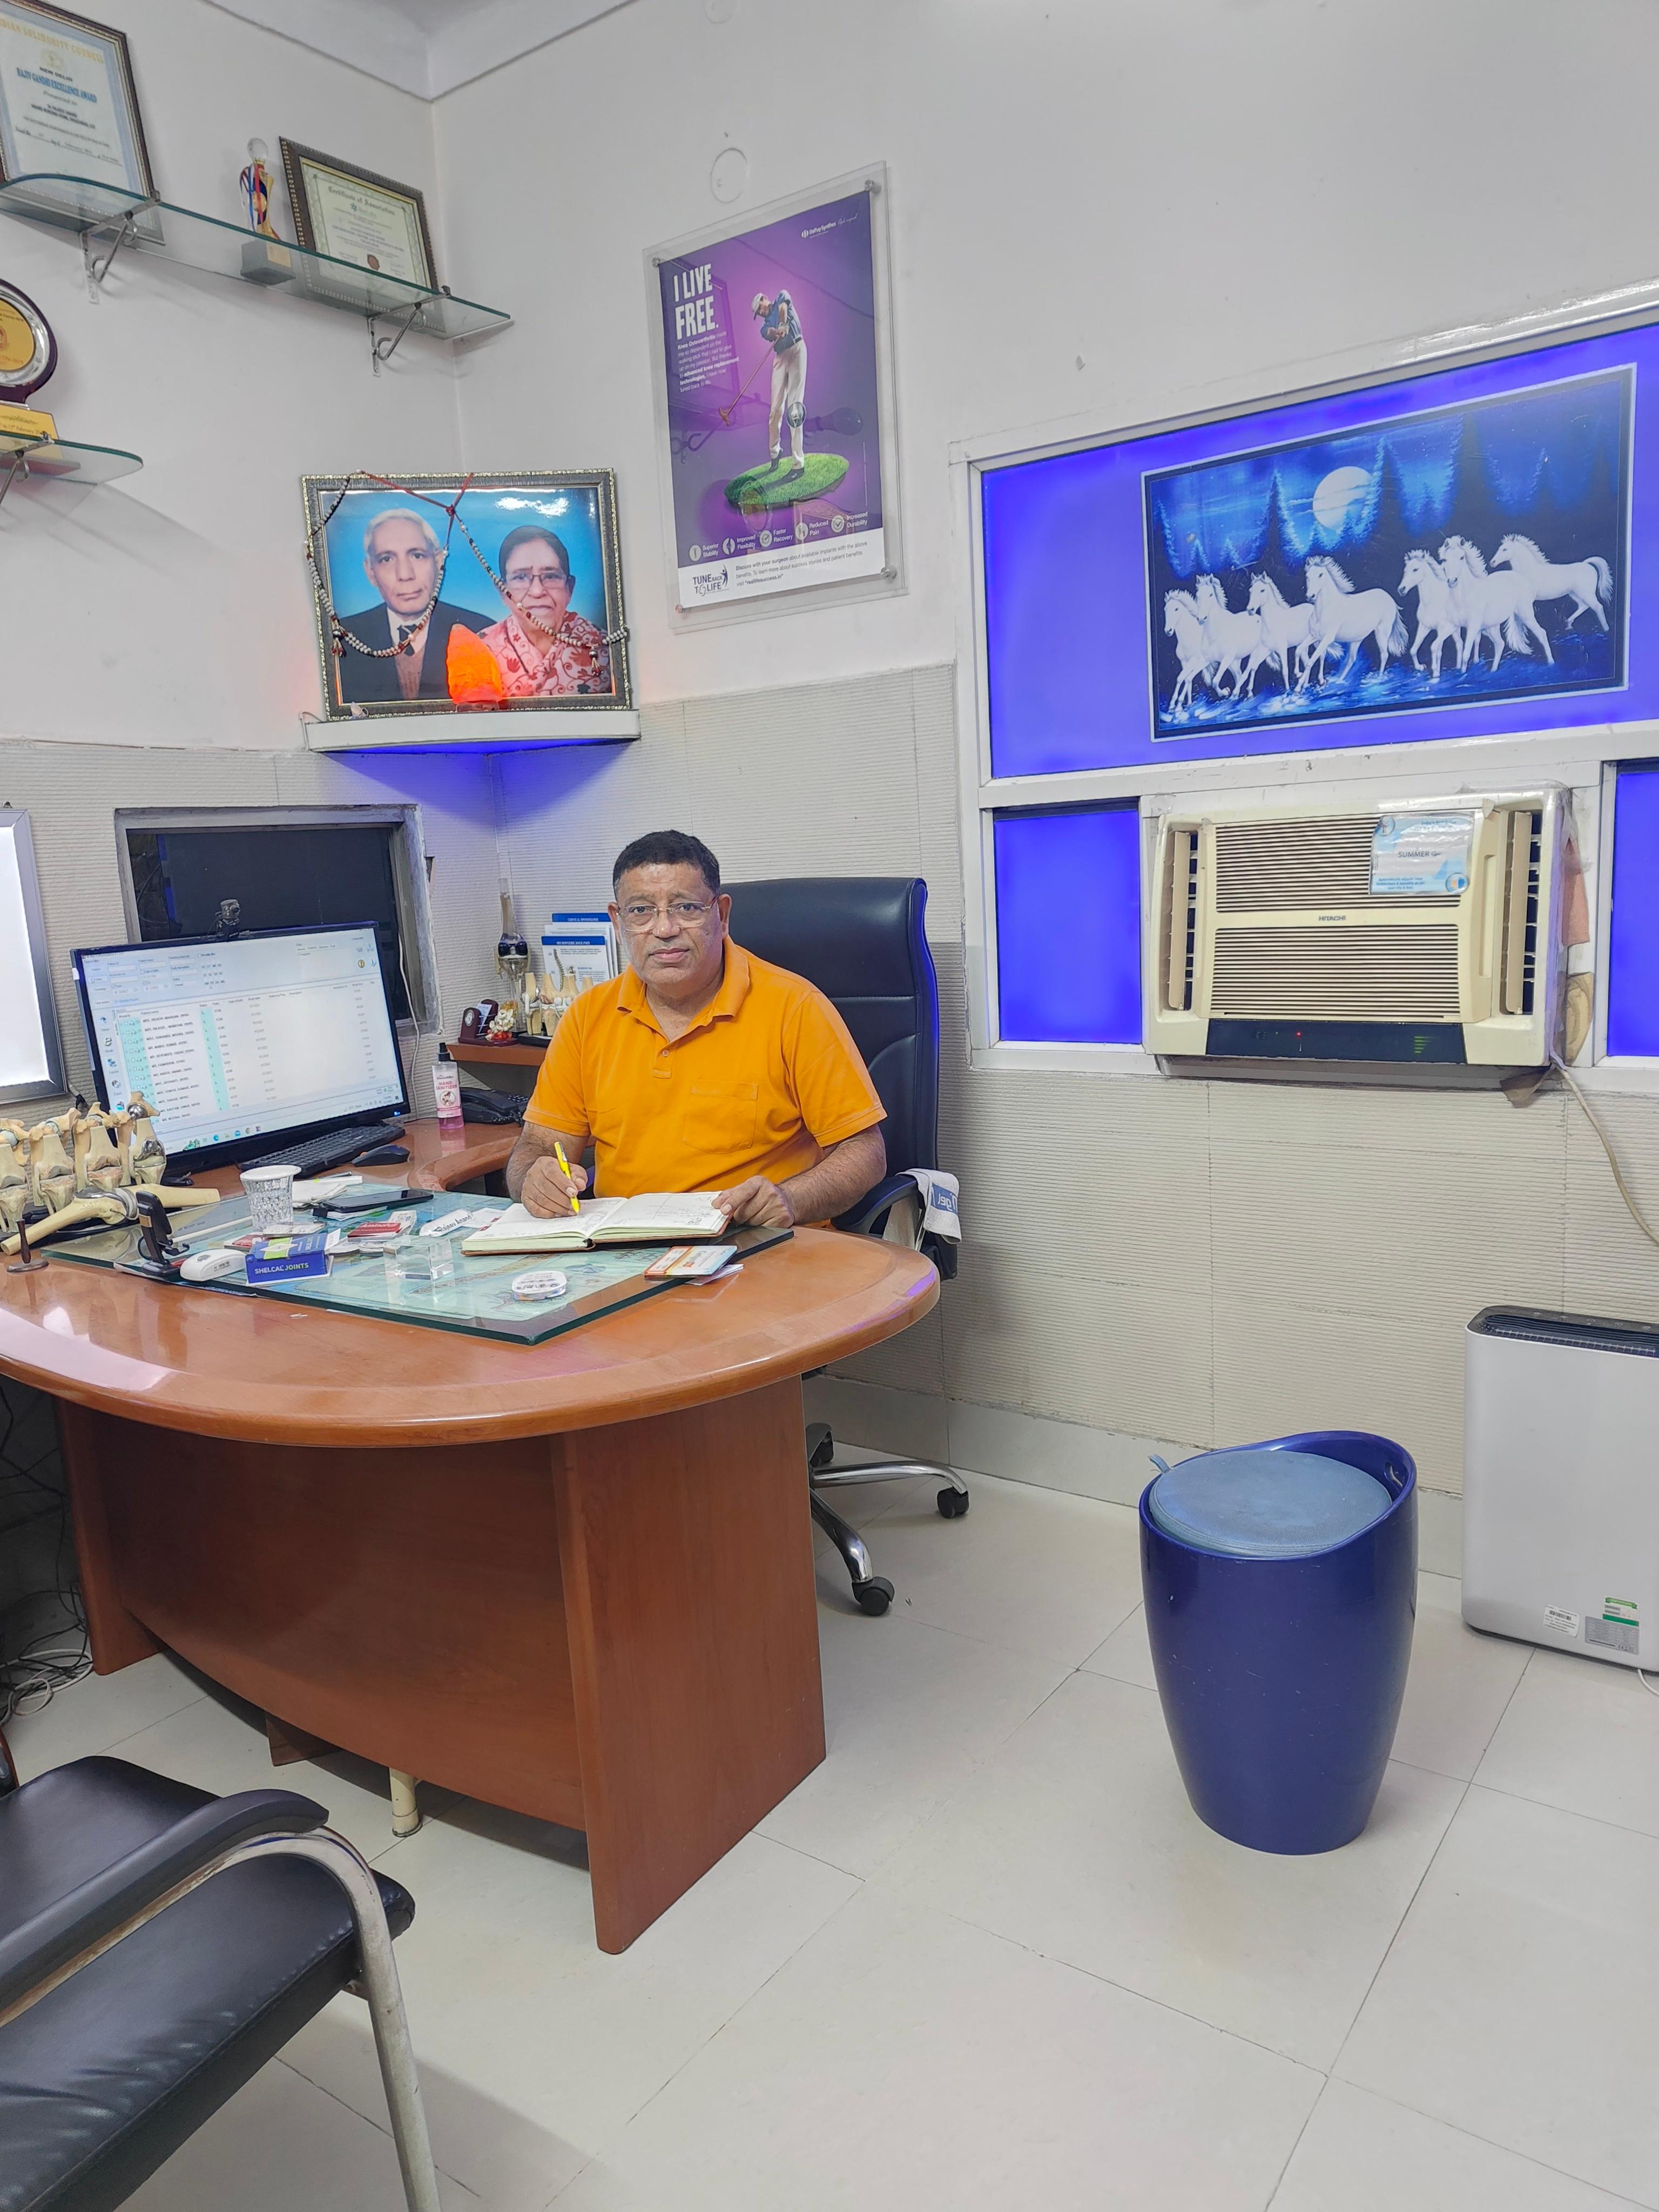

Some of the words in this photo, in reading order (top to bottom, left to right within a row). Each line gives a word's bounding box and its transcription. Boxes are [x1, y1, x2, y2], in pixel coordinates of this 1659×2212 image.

[39, 66, 53, 75] NEW
[328, 185, 355, 201] Certificate
[674, 275, 679, 302] I
[683, 265, 712, 299] LIVE
[675, 295, 719, 340] FREE.
[689, 335, 716, 346] Osteoarthritis
[684, 367, 703, 377] advanced
[714, 356, 739, 368] replacement
[847, 511, 868, 520] Increased
[810, 520, 829, 529] Reduced
[847, 520, 867, 528] Durability
[773, 528, 787, 536] Faster
[737, 535, 756, 543] Improved
[774, 534, 793, 543] Recovery
[703, 543, 719, 551] Superior
[737, 542, 756, 550] Flexibility
[703, 550, 718, 558] Stability
[772, 556, 788, 565] surgeon
[692, 574, 712, 585] TUNE
[706, 582, 721, 591] LIFE
[436, 1221, 456, 1233] Rajeev
[455, 1214, 473, 1225] Anand
[255, 1265, 284, 1274] SHELCAL
[285, 1263, 309, 1271] JOINTS
